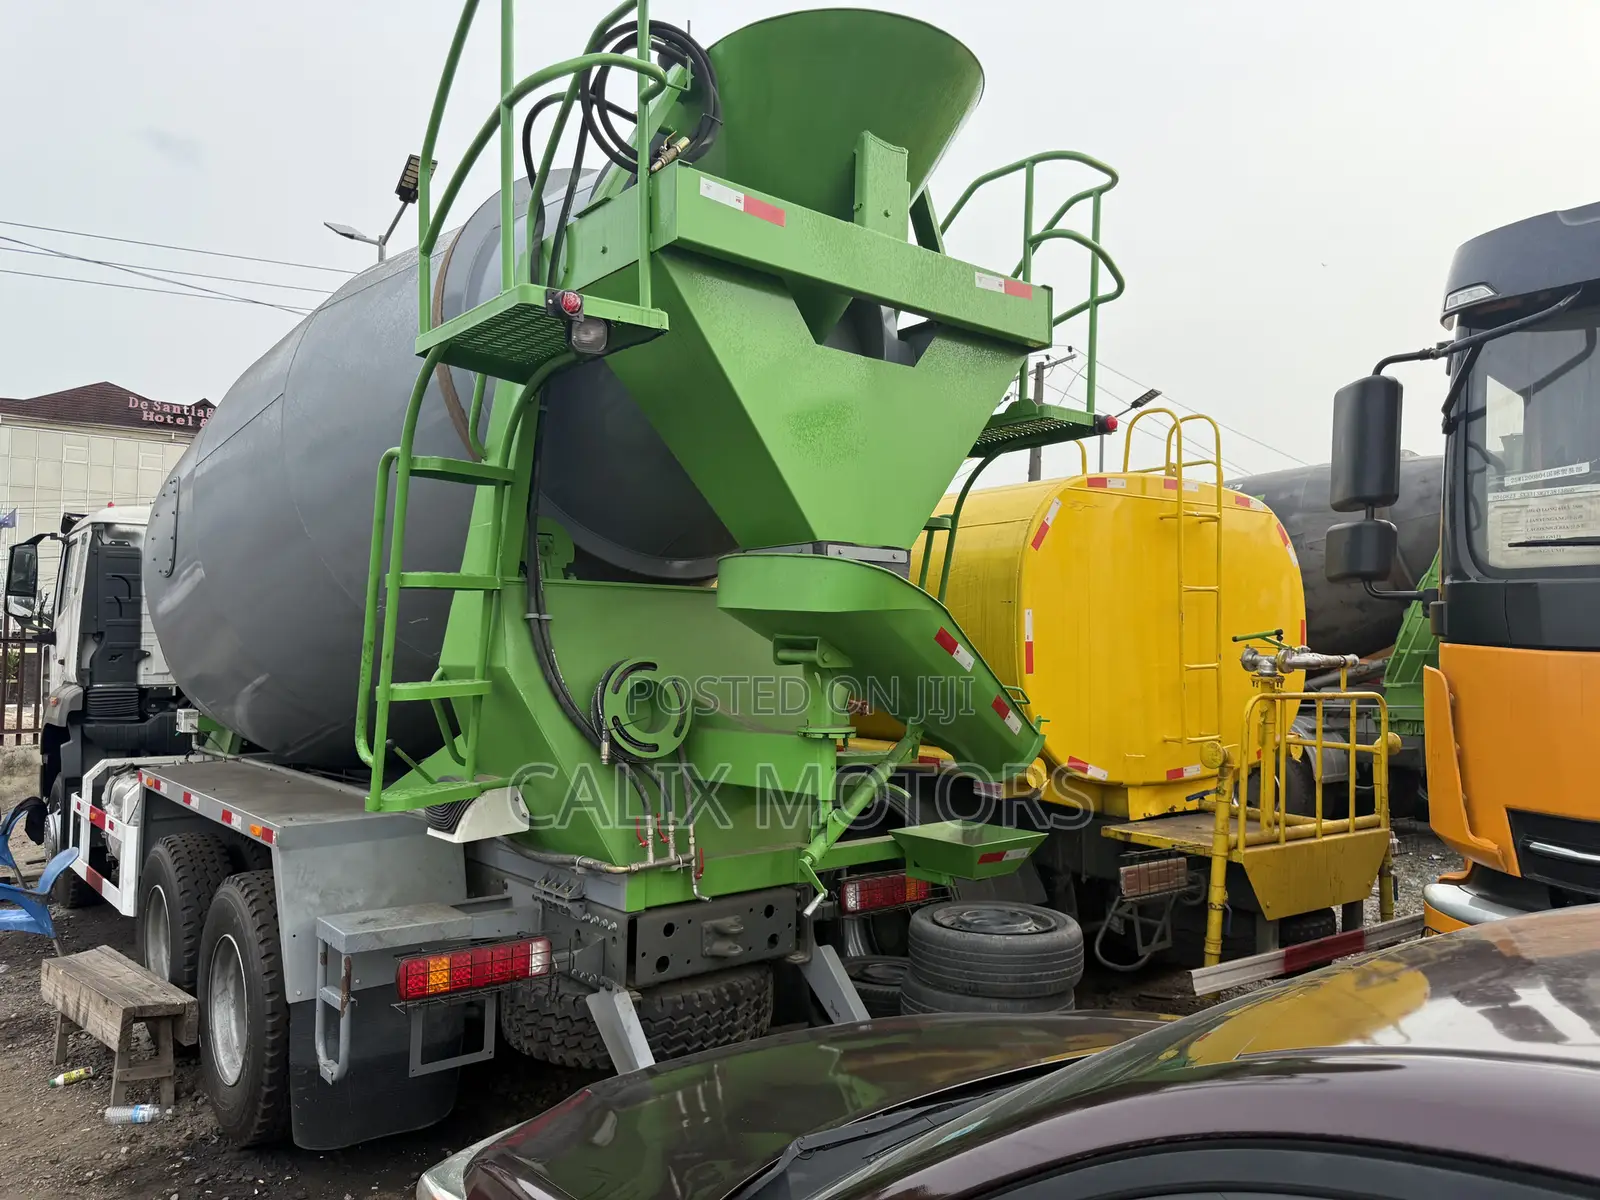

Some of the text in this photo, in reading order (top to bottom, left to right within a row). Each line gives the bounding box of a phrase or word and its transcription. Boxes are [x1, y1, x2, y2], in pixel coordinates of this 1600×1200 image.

[128, 397, 215, 418] De Santiag
[142, 411, 193, 426] Hotel
